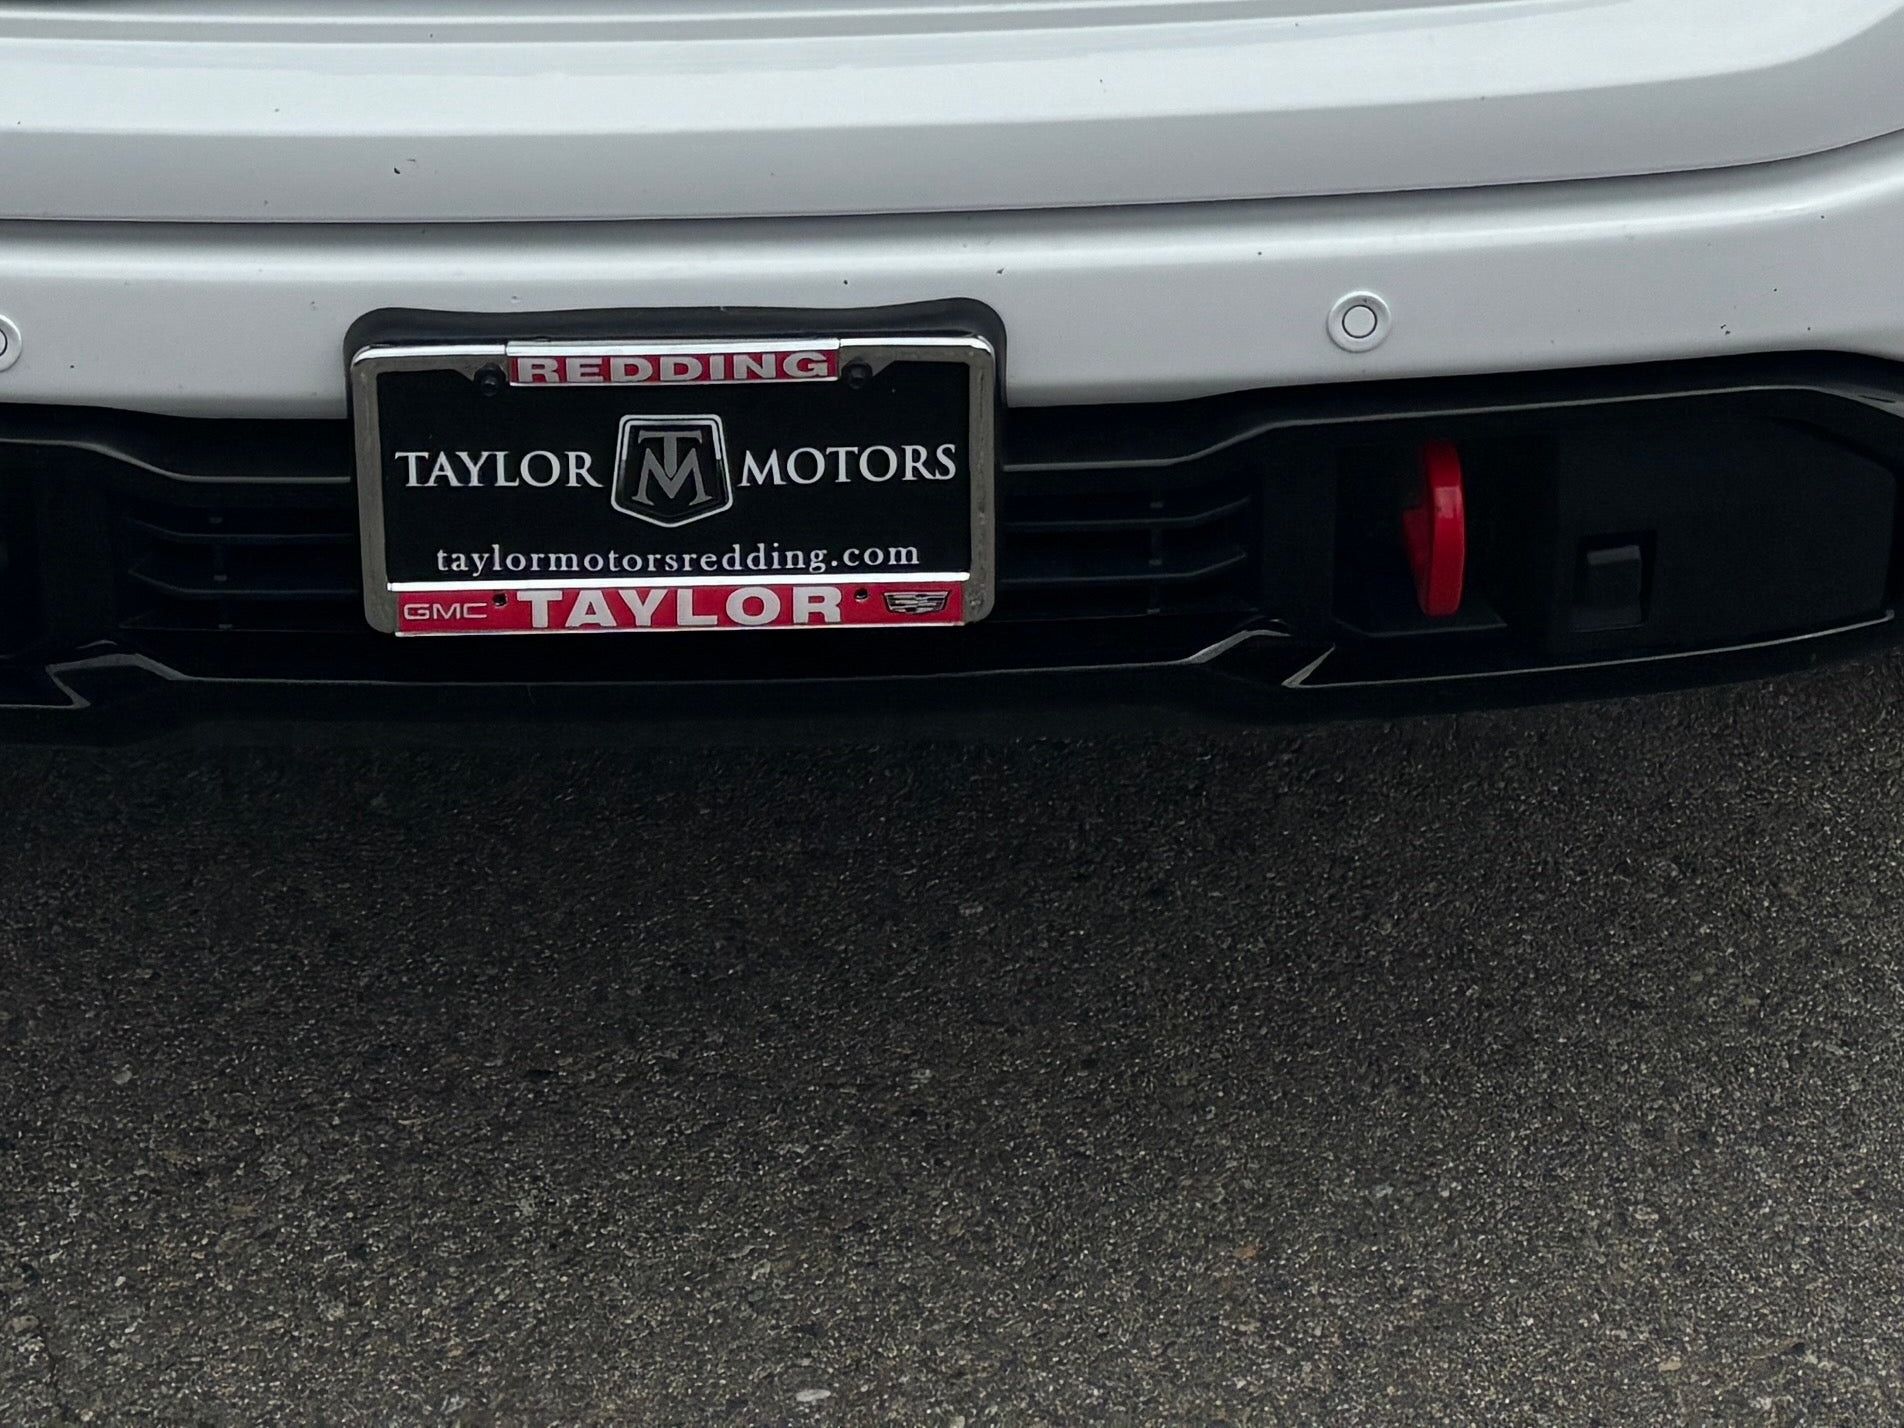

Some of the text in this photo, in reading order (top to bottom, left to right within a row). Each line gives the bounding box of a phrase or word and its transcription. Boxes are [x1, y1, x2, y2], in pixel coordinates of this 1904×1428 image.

[517, 351, 830, 384] REDDING
[395, 450, 604, 489] TAYLOR
[738, 443, 958, 489] MOTORS
[436, 542, 920, 576] taylormotorsredding.com
[403, 585, 844, 629] GMC TAYLOR
